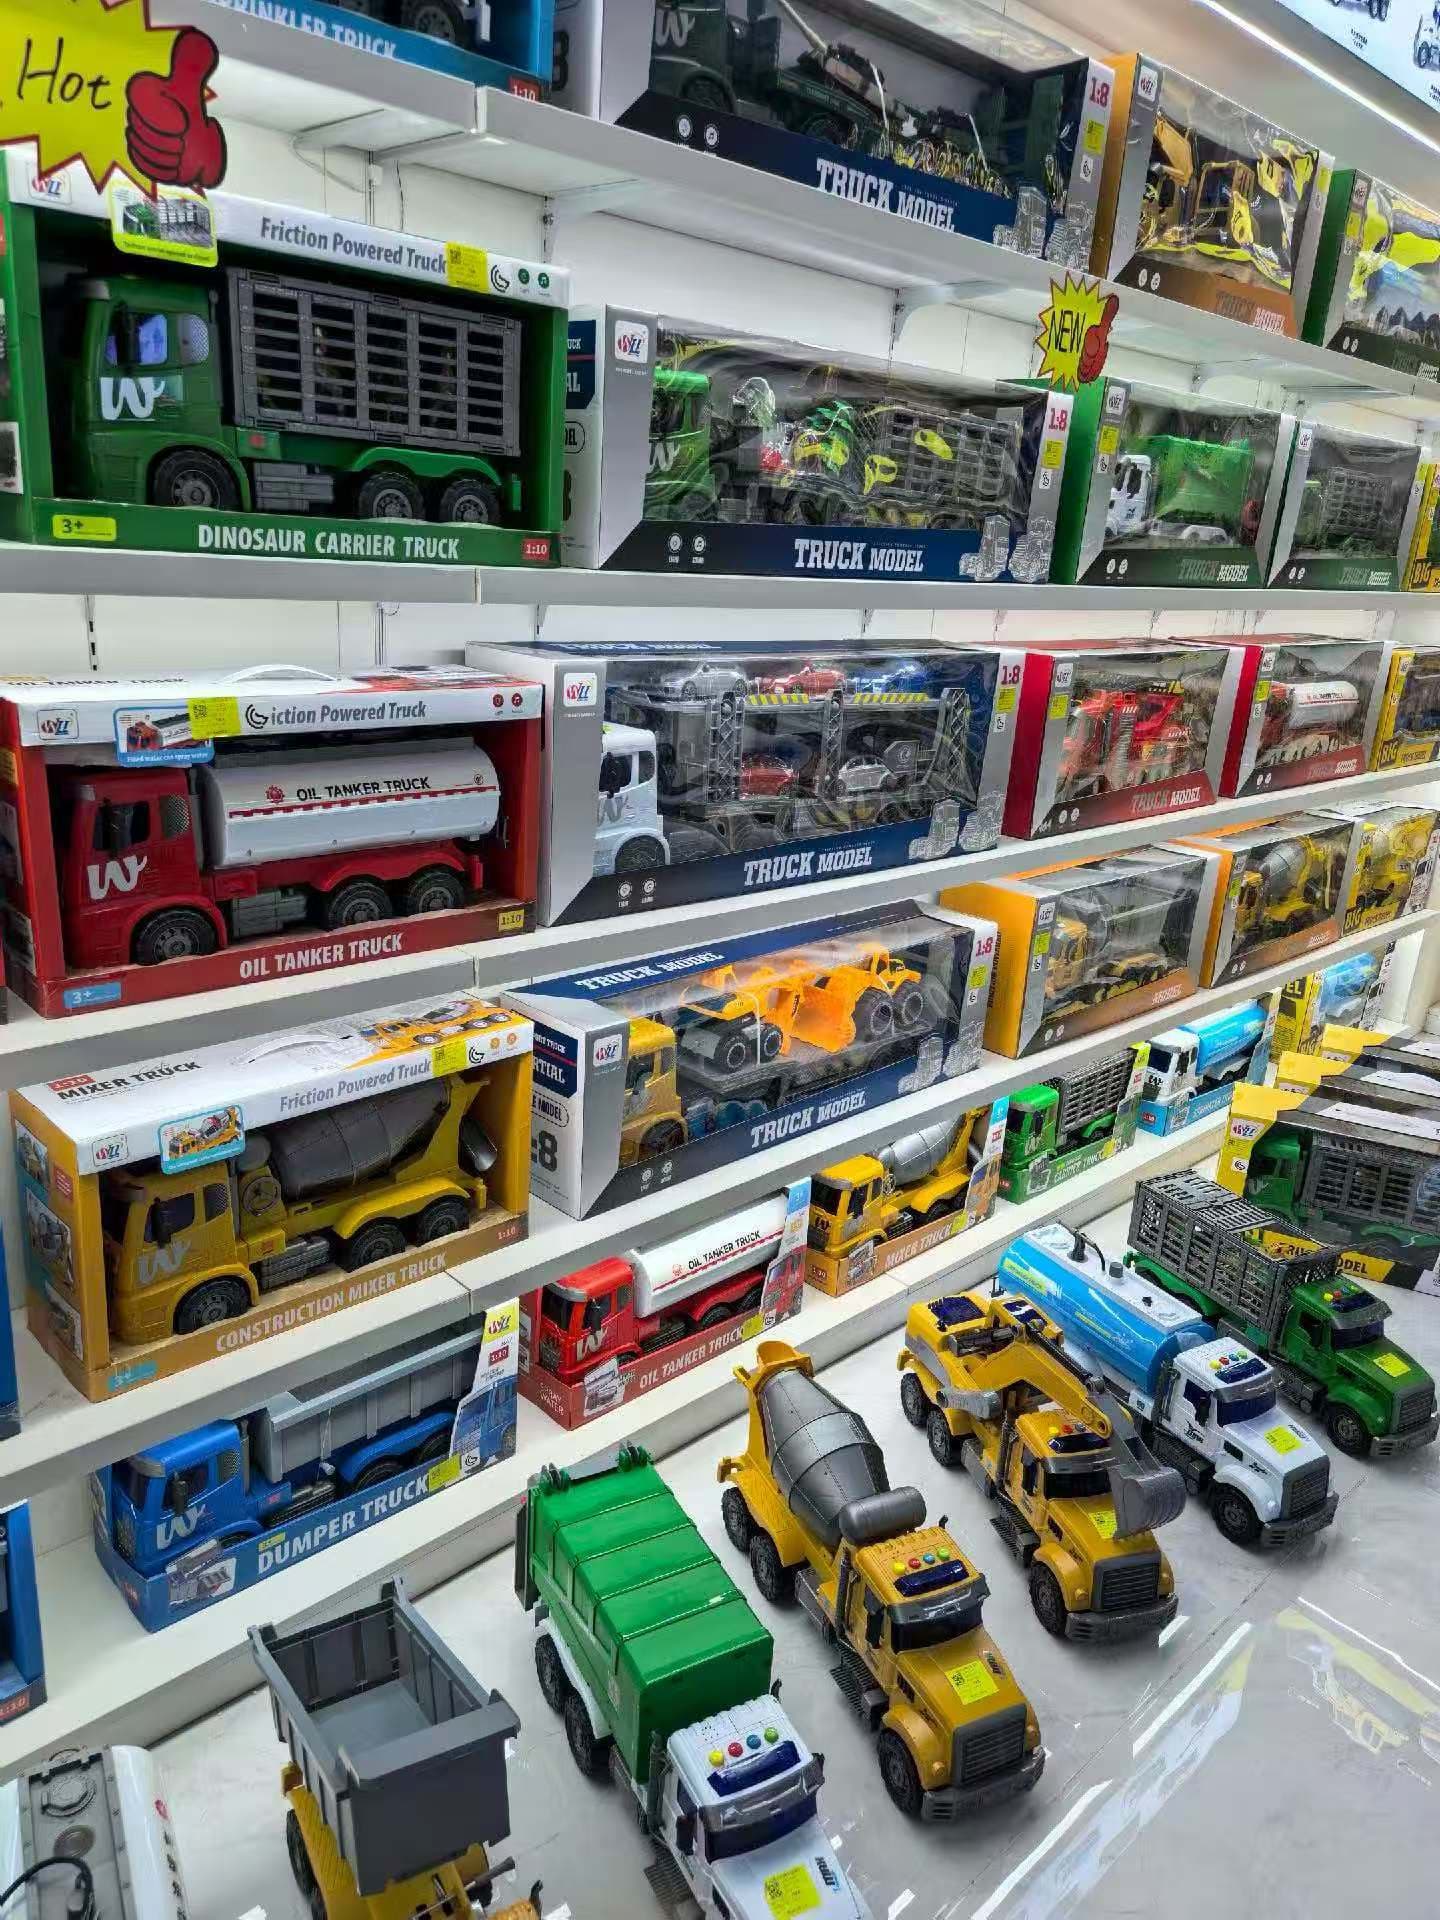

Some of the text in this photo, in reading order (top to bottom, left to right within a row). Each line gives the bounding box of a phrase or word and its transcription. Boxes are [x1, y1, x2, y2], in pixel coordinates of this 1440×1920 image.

[331, 24, 397, 58] TRUCK
[16, 37, 112, 110] Hot
[1088, 77, 1110, 108] 1:8
[816, 157, 956, 232] TRUCK MODEL
[261, 216, 328, 250] Friction
[332, 232, 403, 264] Powered
[407, 248, 446, 275] Truck
[1046, 309, 1086, 353] NEW
[1049, 406, 1068, 432] 1:8
[62, 517, 84, 535] 3+
[199, 523, 459, 560] DINOSAUR CARRIER TRUCK
[525, 543, 548, 556] 1:10
[794, 538, 924, 572] TRUCK MODEL
[1217, 564, 1249, 582] MODEL
[1001, 665, 1020, 686] 1:8
[320, 702, 386, 722] Powered
[388, 700, 427, 719] Truck
[297, 776, 430, 802] OIL TANKER TRUCK
[1168, 786, 1201, 809] MODEL
[744, 846, 873, 886] TRUCK MODEL
[501, 914, 523, 928] 1:10
[239, 932, 403, 979] OIL TANKER TRUCK
[975, 937, 993, 957] 1:8
[575, 951, 726, 990] TRUCK MODEL
[72, 990, 92, 1006] 3+
[57, 1077, 128, 1100] MIXER
[131, 1061, 201, 1082] TRUCK
[280, 1058, 432, 1112] Friction Powered Truck
[538, 1096, 563, 1122] MODEL
[751, 1090, 867, 1149] TRUCK MODEL
[498, 1226, 517, 1240] 1:10
[688, 1230, 761, 1270] OIL TANKER TRUCK
[885, 1223, 952, 1269] MIXER TRUCK
[215, 1252, 447, 1353] CONSTRUCTION MIXER TRUCK
[490, 1349, 508, 1361] 1:10
[639, 1329, 743, 1389] OIL TANKER TRUCK
[258, 1478, 428, 1574] DUMPER TRUCK
